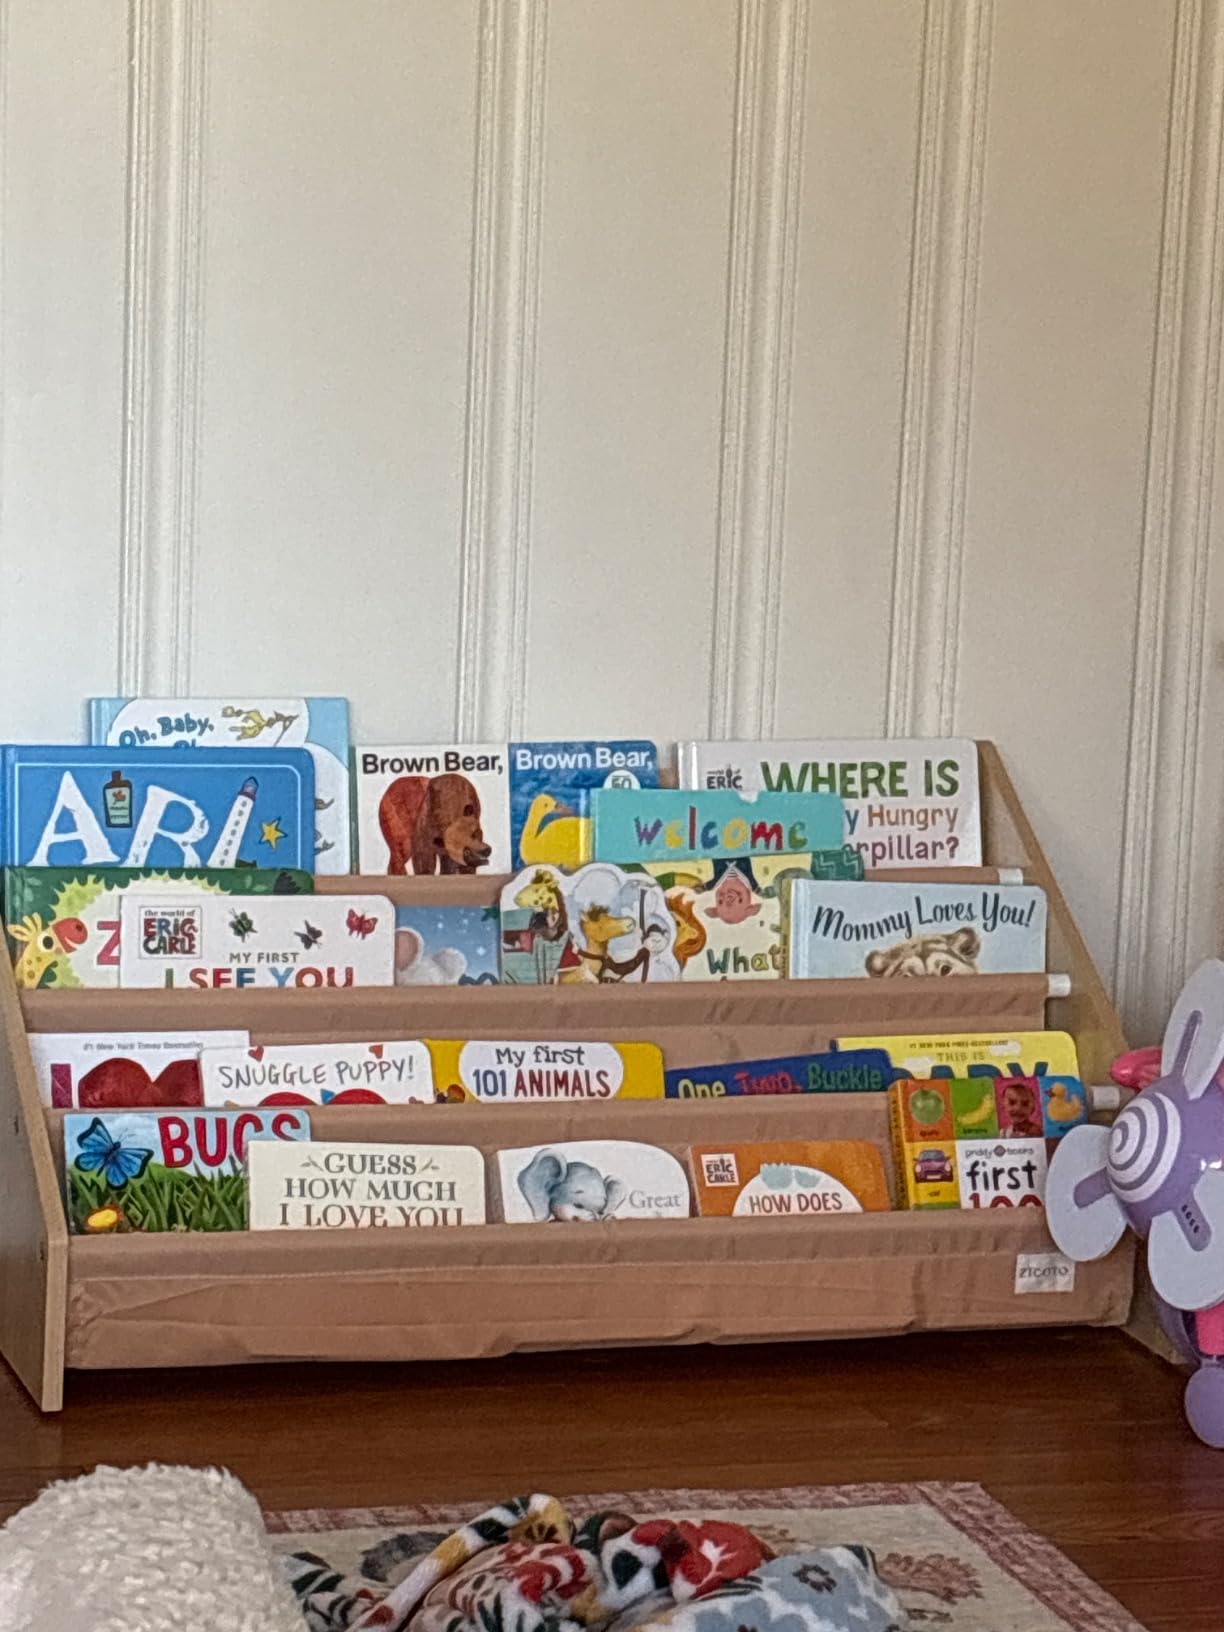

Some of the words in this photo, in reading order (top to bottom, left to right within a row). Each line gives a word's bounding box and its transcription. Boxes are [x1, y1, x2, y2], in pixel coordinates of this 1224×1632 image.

[362, 754, 439, 774] Brown
[444, 752, 503, 774] Bear,
[516, 749, 591, 771] Brown
[595, 748, 653, 771] Bear,
[706, 771, 743, 790] ERIC
[760, 760, 907, 799] WHERE
[924, 760, 960, 798] IS
[867, 804, 959, 833] Hungry
[143, 918, 198, 936] ERIC
[812, 905, 913, 942] Mommy
[915, 896, 977, 925] Loves
[982, 892, 1036, 932] You!
[143, 935, 197, 954] CARLE
[229, 952, 251, 963] MY
[257, 952, 300, 963] FIRST
[706, 944, 781, 975] What
[268, 966, 354, 988] YOU
[495, 1048, 525, 1067] My
[533, 1045, 585, 1065] first
[218, 1062, 326, 1088] SNUGGLE
[336, 1055, 415, 1084] PUPPY!
[807, 1062, 883, 1091] Buckle
[472, 1069, 507, 1097] 101
[514, 1069, 611, 1097] ANIMALS
[324, 1153, 417, 1175] GUESS
[706, 1160, 733, 1173] ERIC
[966, 1160, 1037, 1191] first
[284, 1178, 356, 1199] HOW
[367, 1180, 457, 1201] MUCH
[629, 1190, 681, 1209] Great
[750, 1194, 791, 1214] HOW
[796, 1193, 843, 1211] DOES
[280, 1203, 289, 1225] I
[304, 1204, 388, 1228] LOVE
[396, 1206, 463, 1227] YOU
